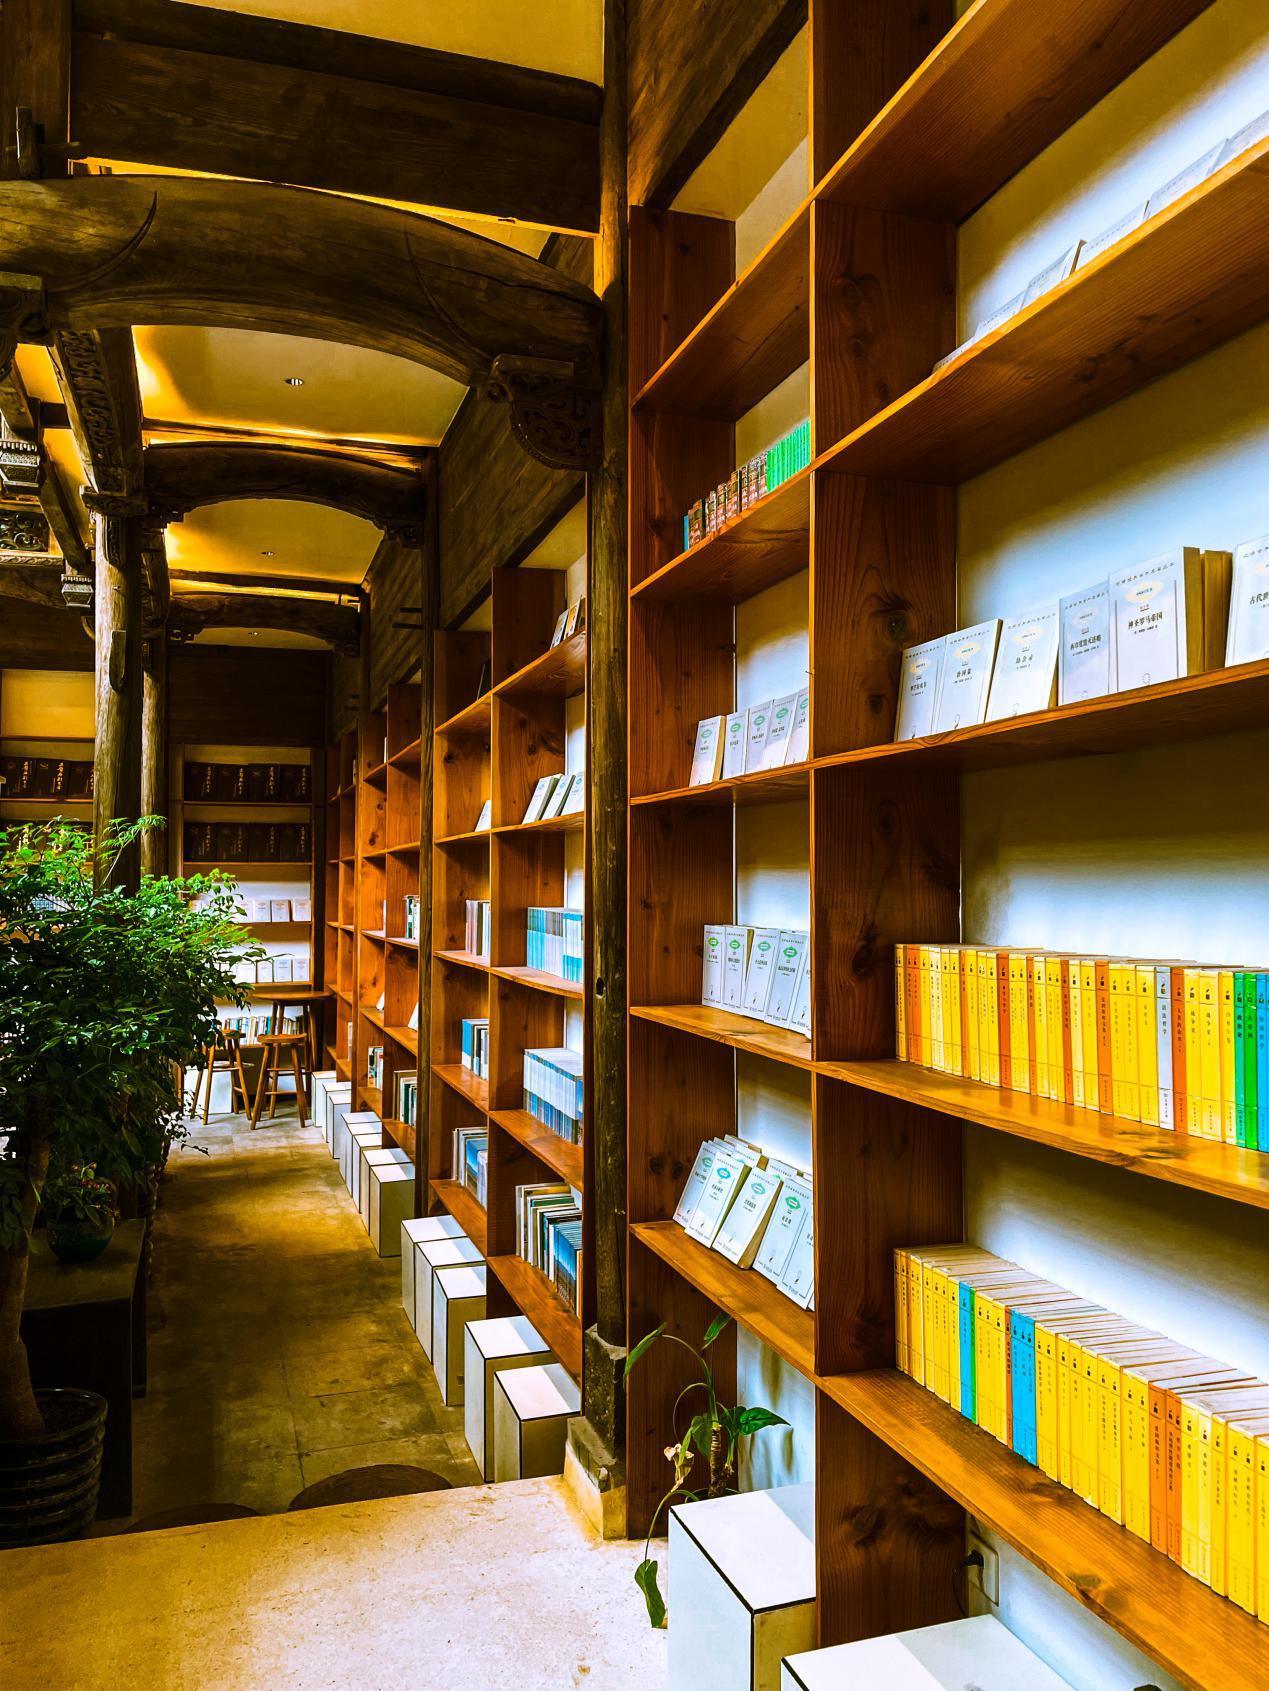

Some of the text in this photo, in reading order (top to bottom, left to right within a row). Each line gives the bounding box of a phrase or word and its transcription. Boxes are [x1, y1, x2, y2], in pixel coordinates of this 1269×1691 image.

[1127, 611, 1163, 630] 神圣罗马帝国
